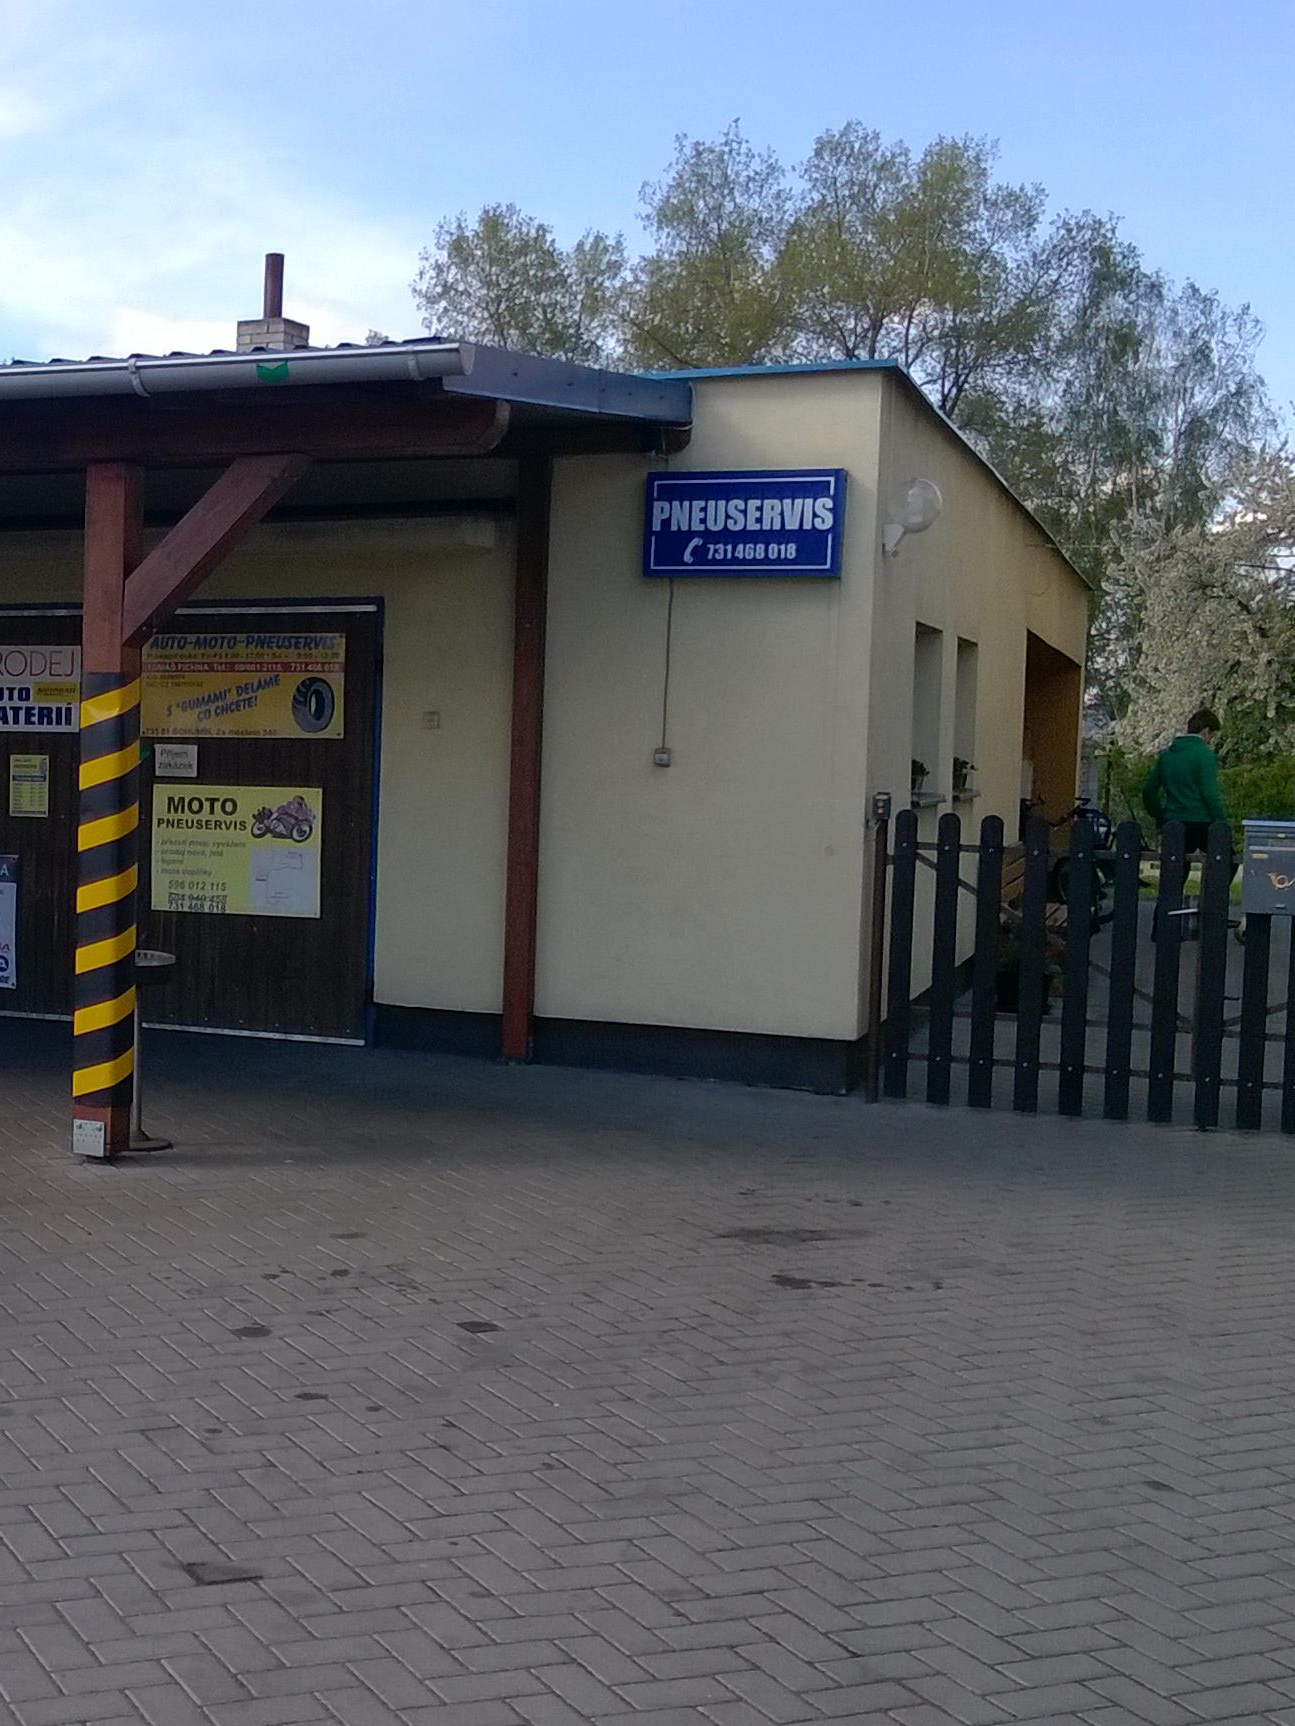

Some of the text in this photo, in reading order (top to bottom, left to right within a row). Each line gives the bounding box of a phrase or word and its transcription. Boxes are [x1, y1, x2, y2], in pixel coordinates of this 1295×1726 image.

[652, 498, 833, 531] PNEUSERVIS
[196, 708, 212, 722] CO
[167, 796, 237, 816] MOTO
[157, 817, 247, 831] PNEUSERVIS
[168, 880, 227, 892] 596 012 115
